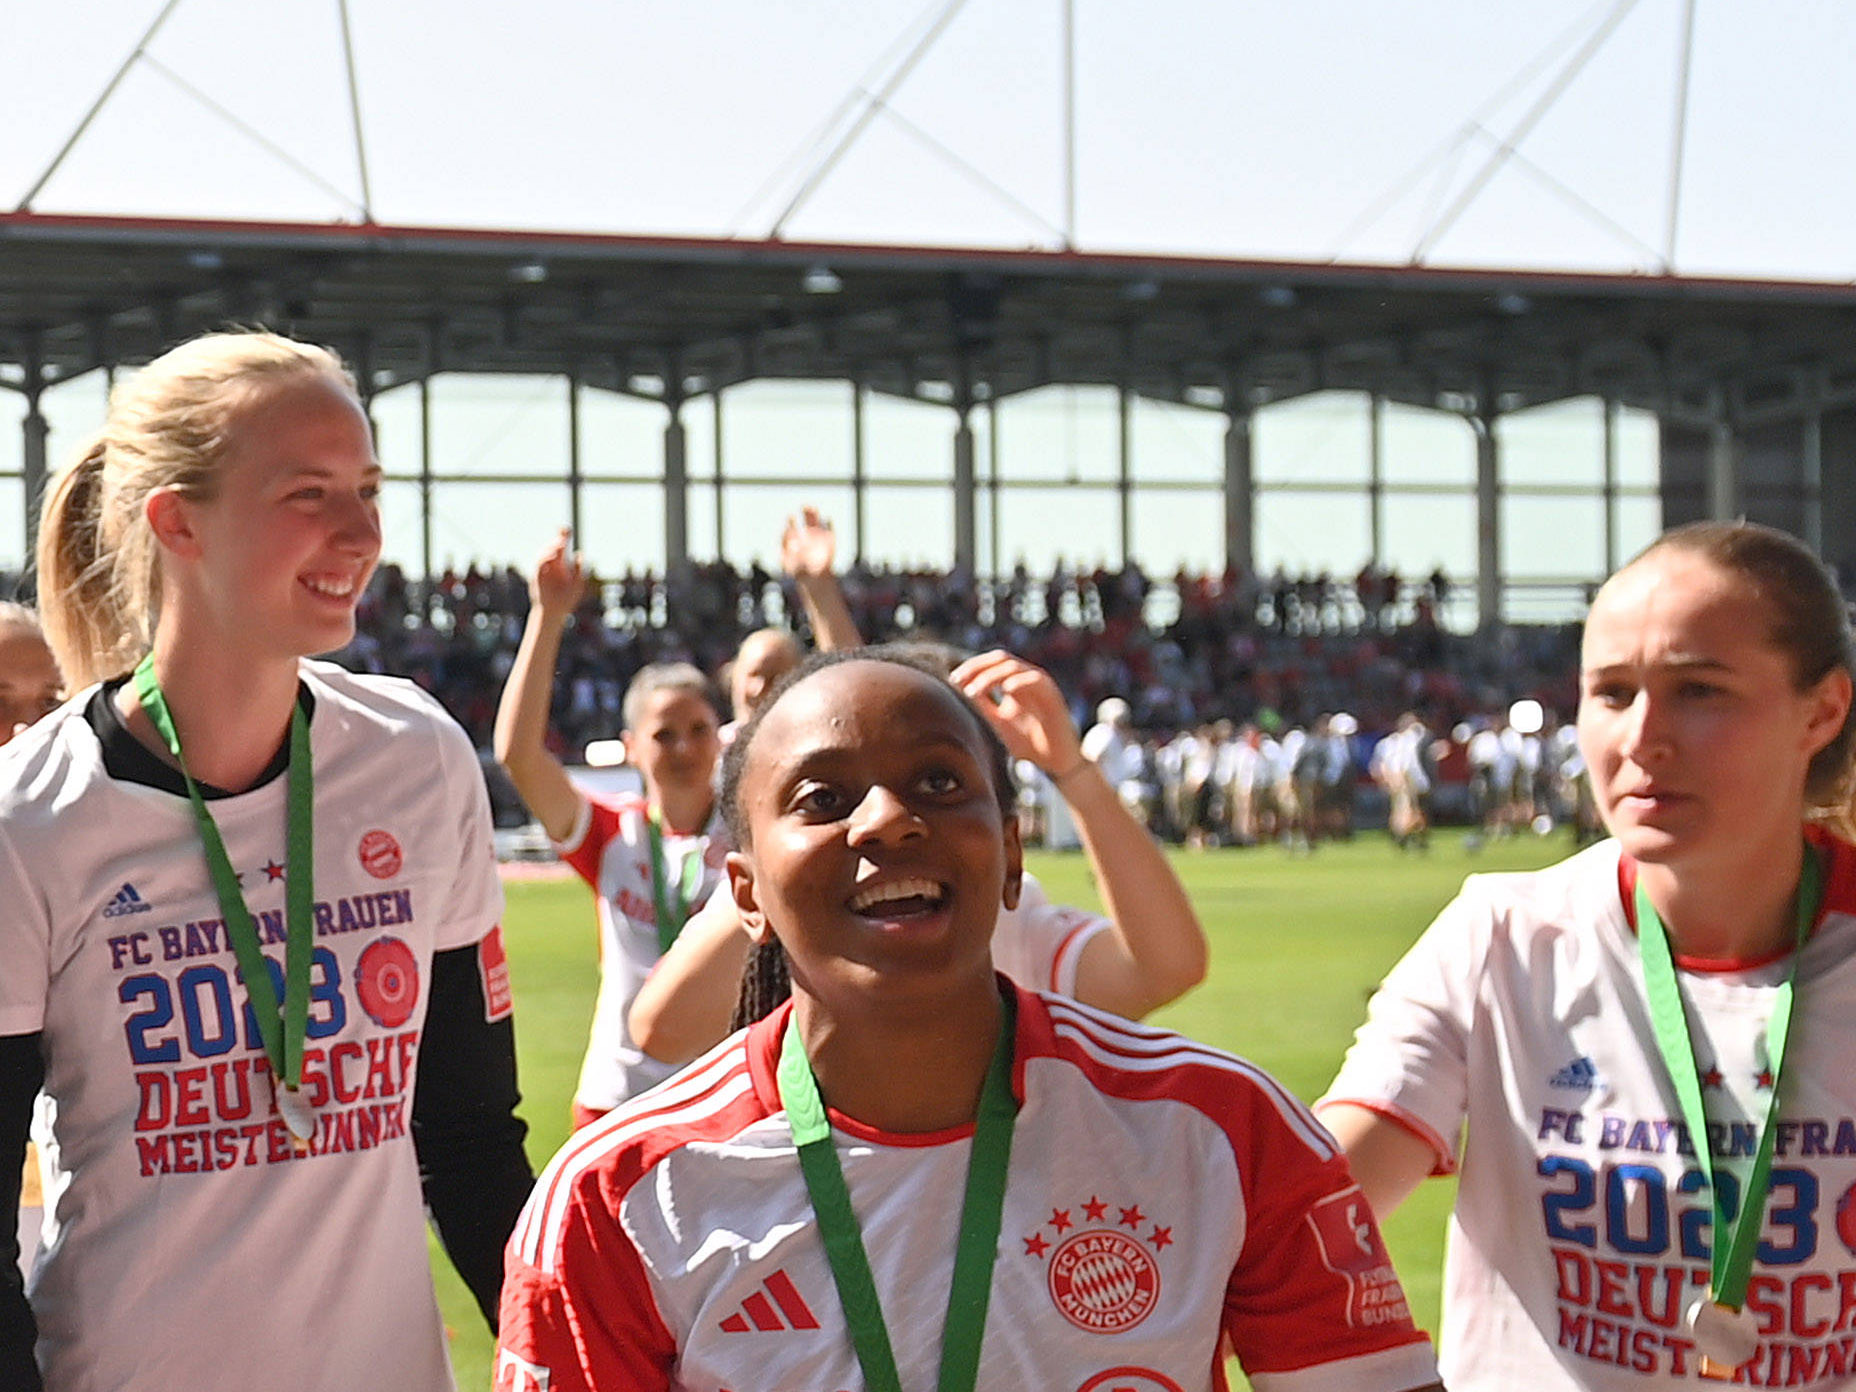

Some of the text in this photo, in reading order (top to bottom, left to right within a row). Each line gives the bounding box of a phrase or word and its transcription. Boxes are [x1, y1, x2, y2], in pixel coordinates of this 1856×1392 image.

[108, 932, 152, 970] FC
[313, 889, 414, 937] RAUEN
[1538, 1107, 1585, 1145] FC
[1775, 1116, 1856, 1156] FRA
[1056, 1236, 1149, 1277] FC BAYERN
